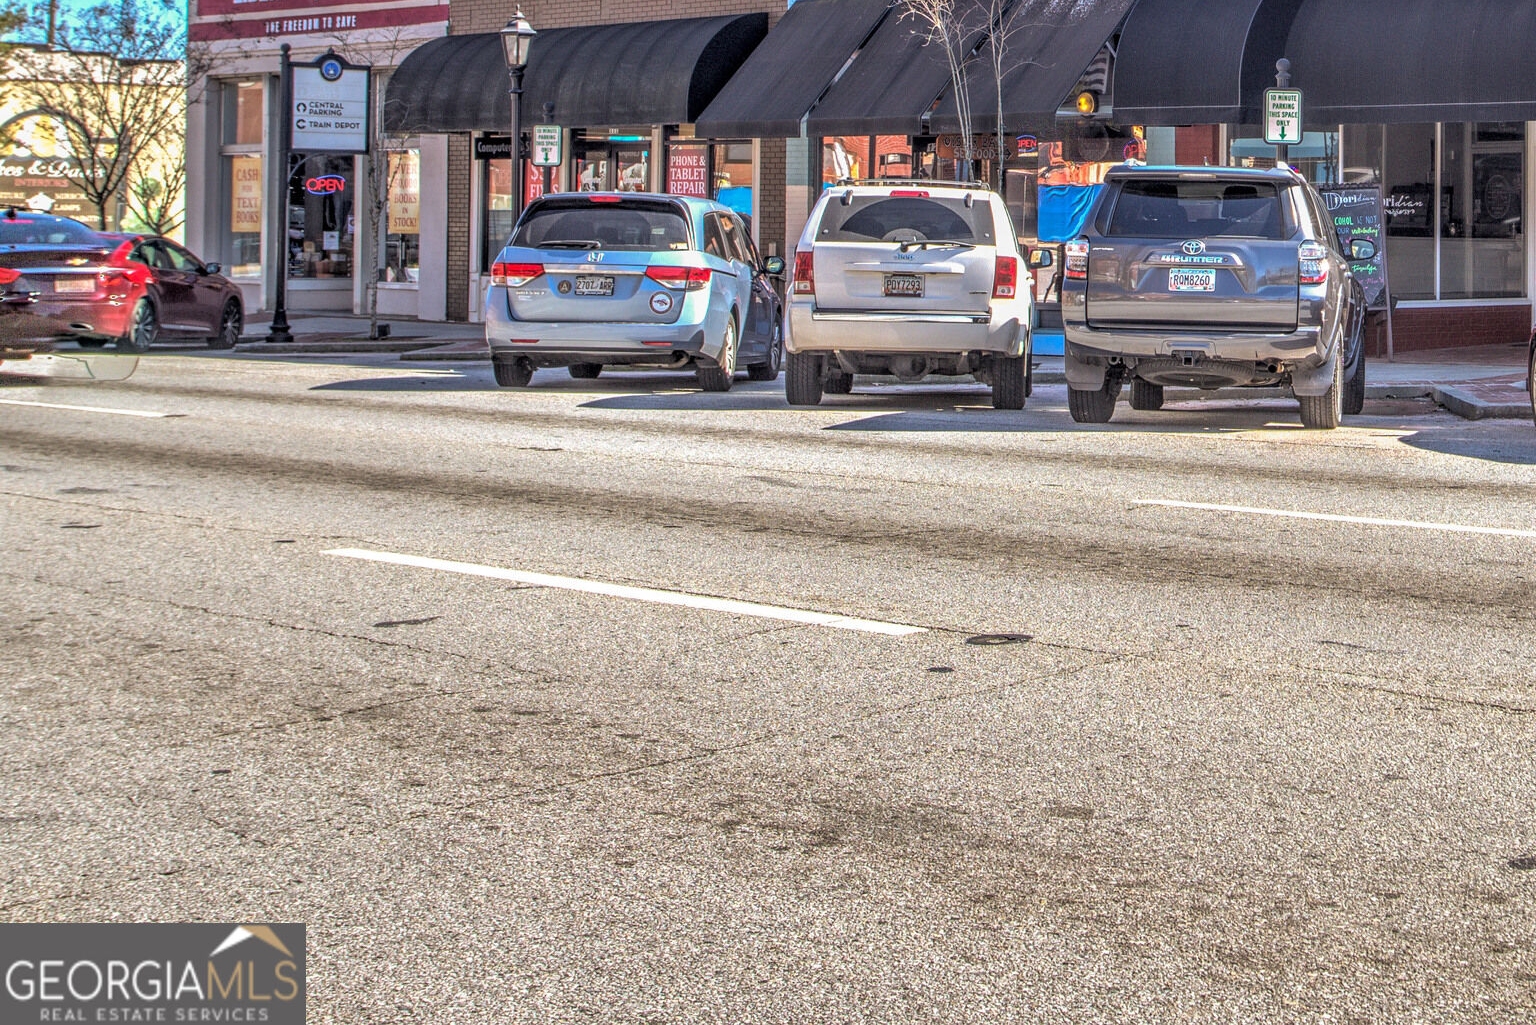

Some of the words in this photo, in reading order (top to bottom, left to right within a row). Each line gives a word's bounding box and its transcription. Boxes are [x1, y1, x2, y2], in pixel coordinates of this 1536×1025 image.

[283, 18, 319, 32] FREEDOM
[323, 17, 333, 29] TO
[336, 15, 357, 28] SAVE
[309, 101, 344, 110] CENTRAL
[334, 122, 361, 130] DEPOT
[670, 155, 697, 166] PHONE
[698, 157, 706, 167] &
[237, 168, 259, 182] CASH
[670, 168, 706, 180] TABLET
[305, 177, 345, 192] OPEN
[670, 181, 705, 194] REPAIR
[237, 197, 259, 208] TEXT
[394, 194, 417, 204] BOOKS
[236, 211, 259, 223] BOOKS
[394, 217, 417, 227] STOCK!
[1161, 255, 1223, 263] 4RUNNER
